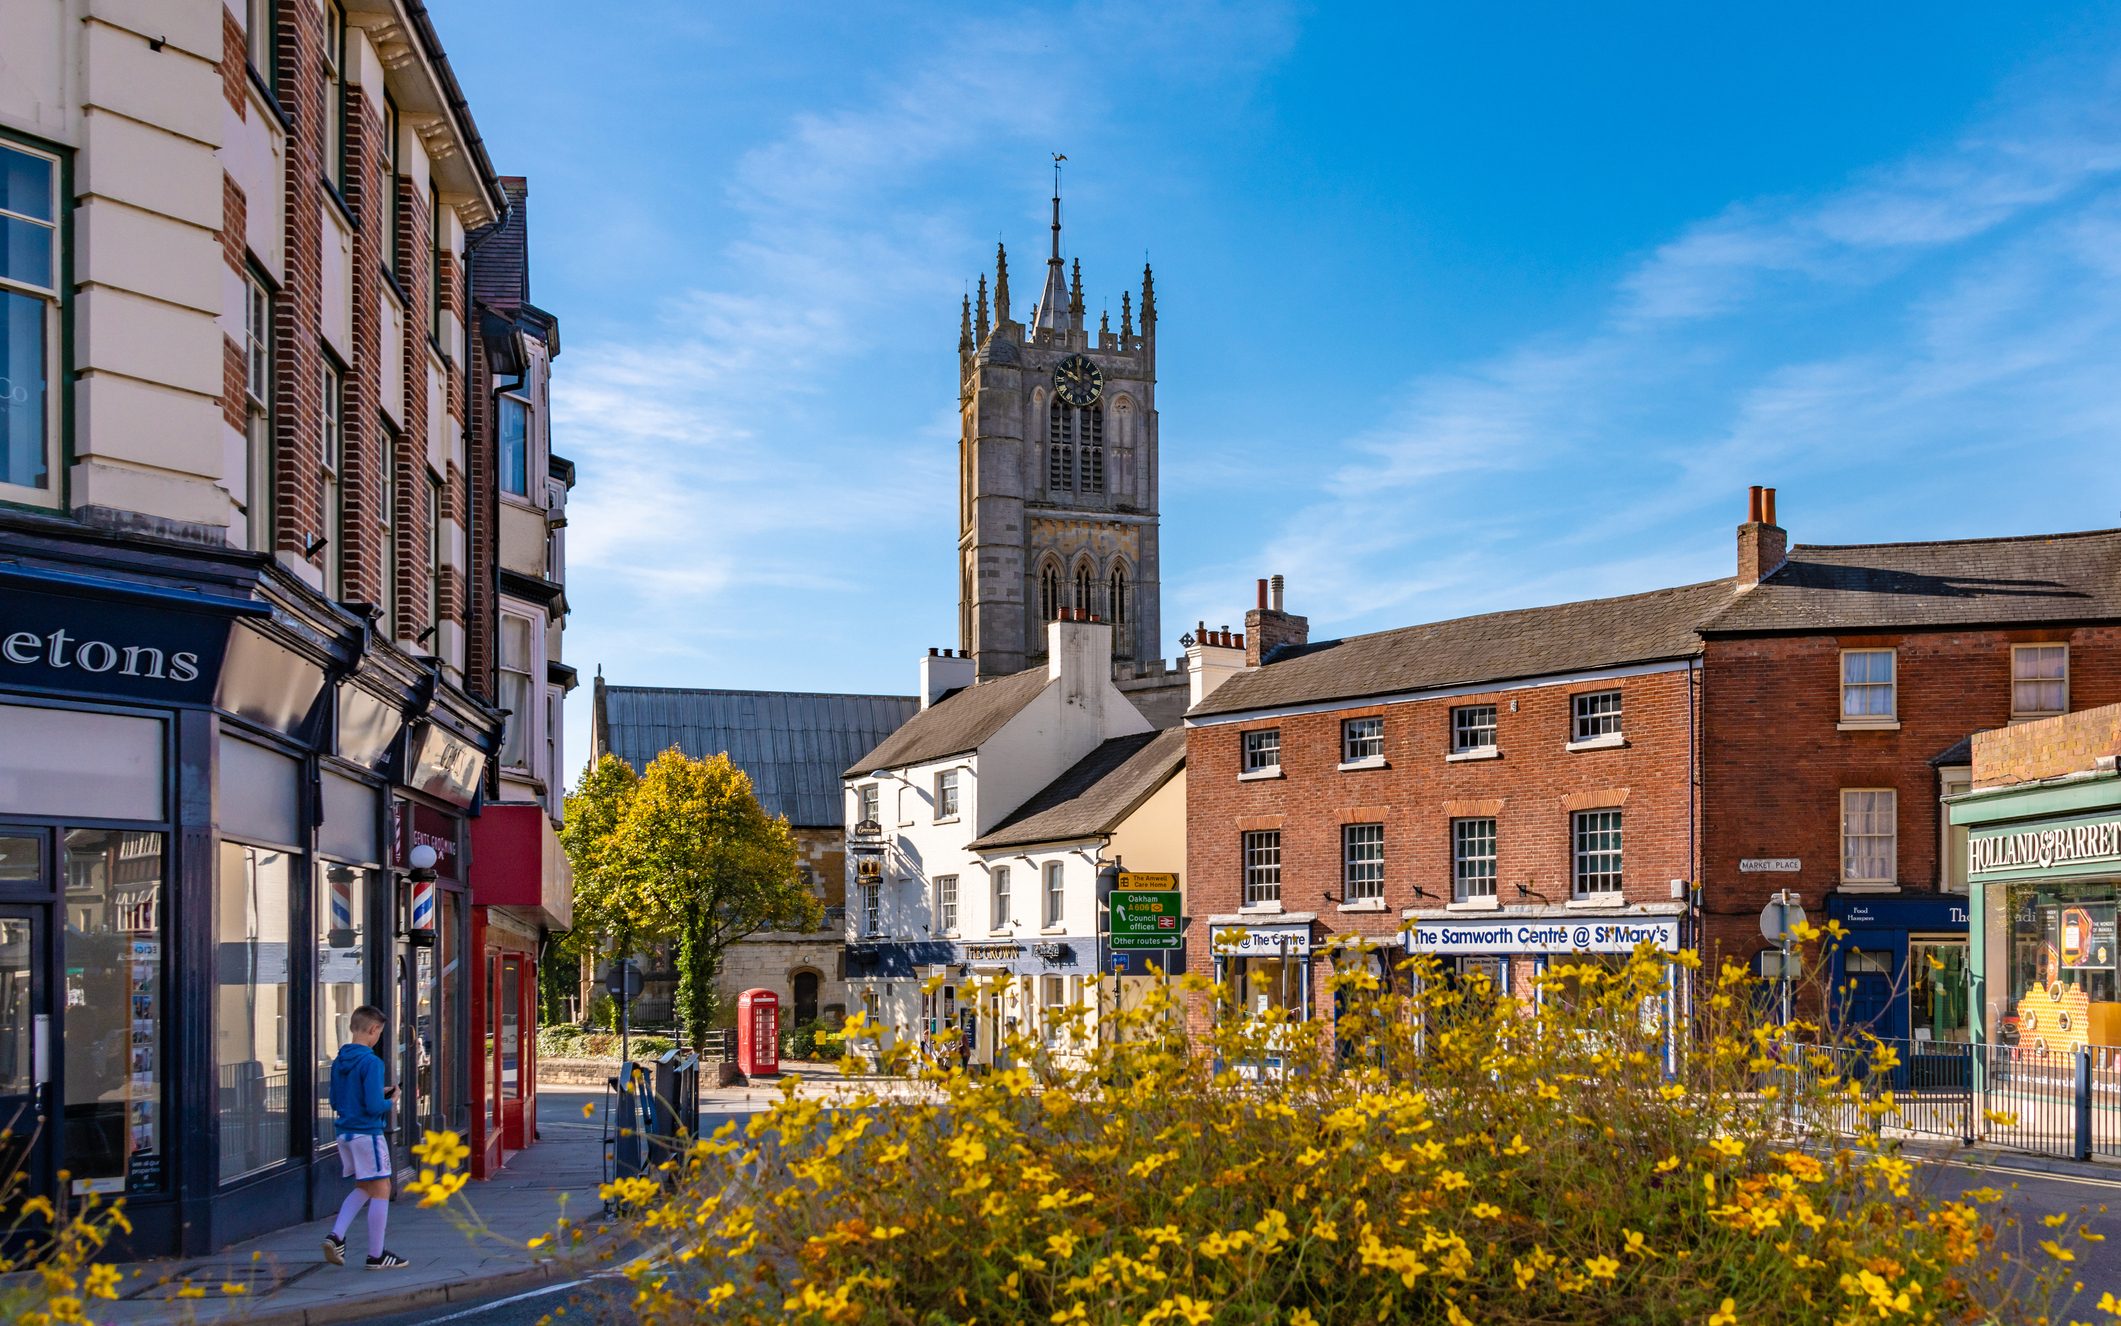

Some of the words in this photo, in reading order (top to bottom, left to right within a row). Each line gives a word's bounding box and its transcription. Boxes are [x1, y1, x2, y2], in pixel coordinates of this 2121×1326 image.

[2, 628, 199, 682] etons
[1775, 861, 1798, 869] PLACE
[1128, 895, 1158, 903] Oakham
[1128, 914, 1157, 922] Council
[1847, 914, 1875, 922] Hampers
[1129, 923, 1155, 931] offices
[1113, 937, 1135, 945] Other
[1253, 933, 1269, 946] The
[1415, 928, 1438, 944] The
[1441, 927, 1513, 944] Samworth
[1517, 926, 1568, 944] Centre
[1573, 926, 1590, 948] @
[965, 945, 982, 960] THE
[984, 945, 1020, 960] CROWN
